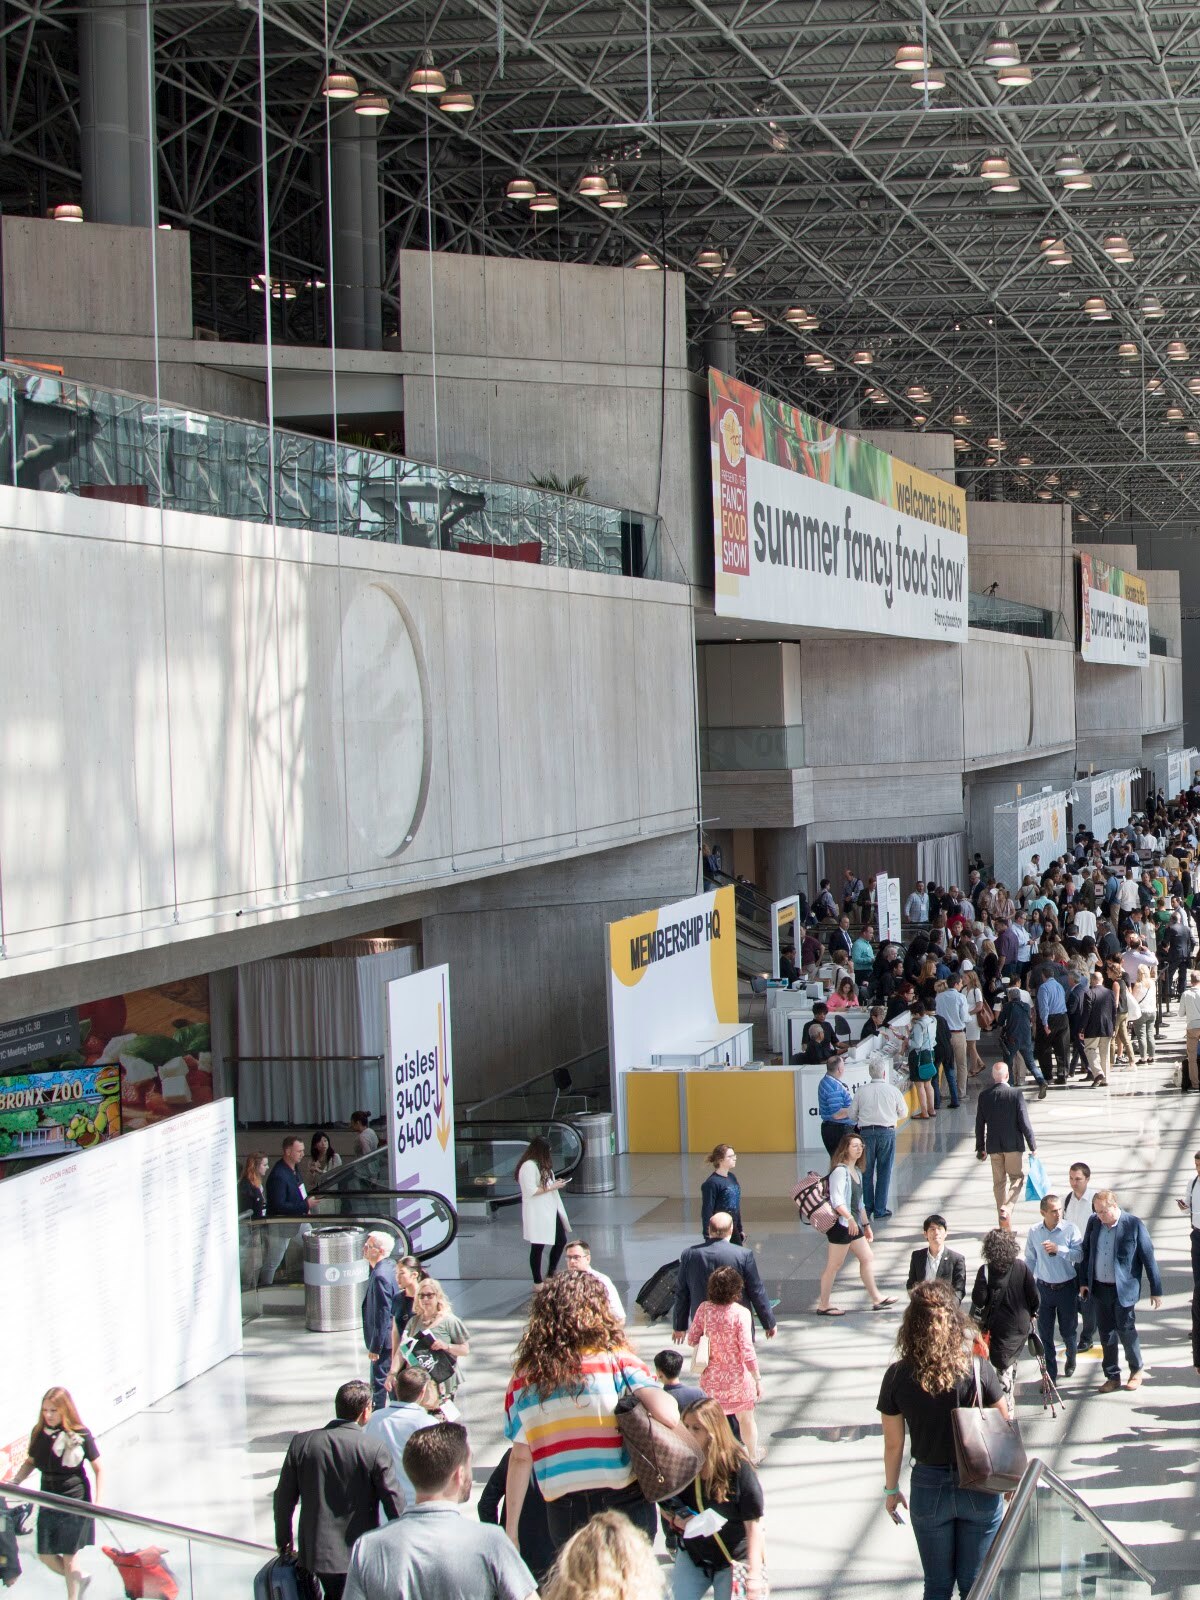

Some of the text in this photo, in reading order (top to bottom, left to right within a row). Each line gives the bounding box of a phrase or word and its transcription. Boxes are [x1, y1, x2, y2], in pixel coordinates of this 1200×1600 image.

[721, 483, 746, 512] FANCY
[896, 474, 962, 534] welcome to the
[723, 510, 747, 542] FOOD
[723, 540, 747, 569] SHOW
[753, 501, 963, 609] summer fancy food show
[630, 909, 721, 971] MEMBERSHIP HQ
[7, 1045, 28, 1057] Meeting
[27, 1041, 45, 1052] Rooms
[396, 1050, 435, 1085] aisles
[51, 1080, 83, 1103] ZOO
[396, 1079, 436, 1120] 3400-
[397, 1113, 432, 1154] 6400
[40, 1164, 77, 1185] LOCATION FINDER
